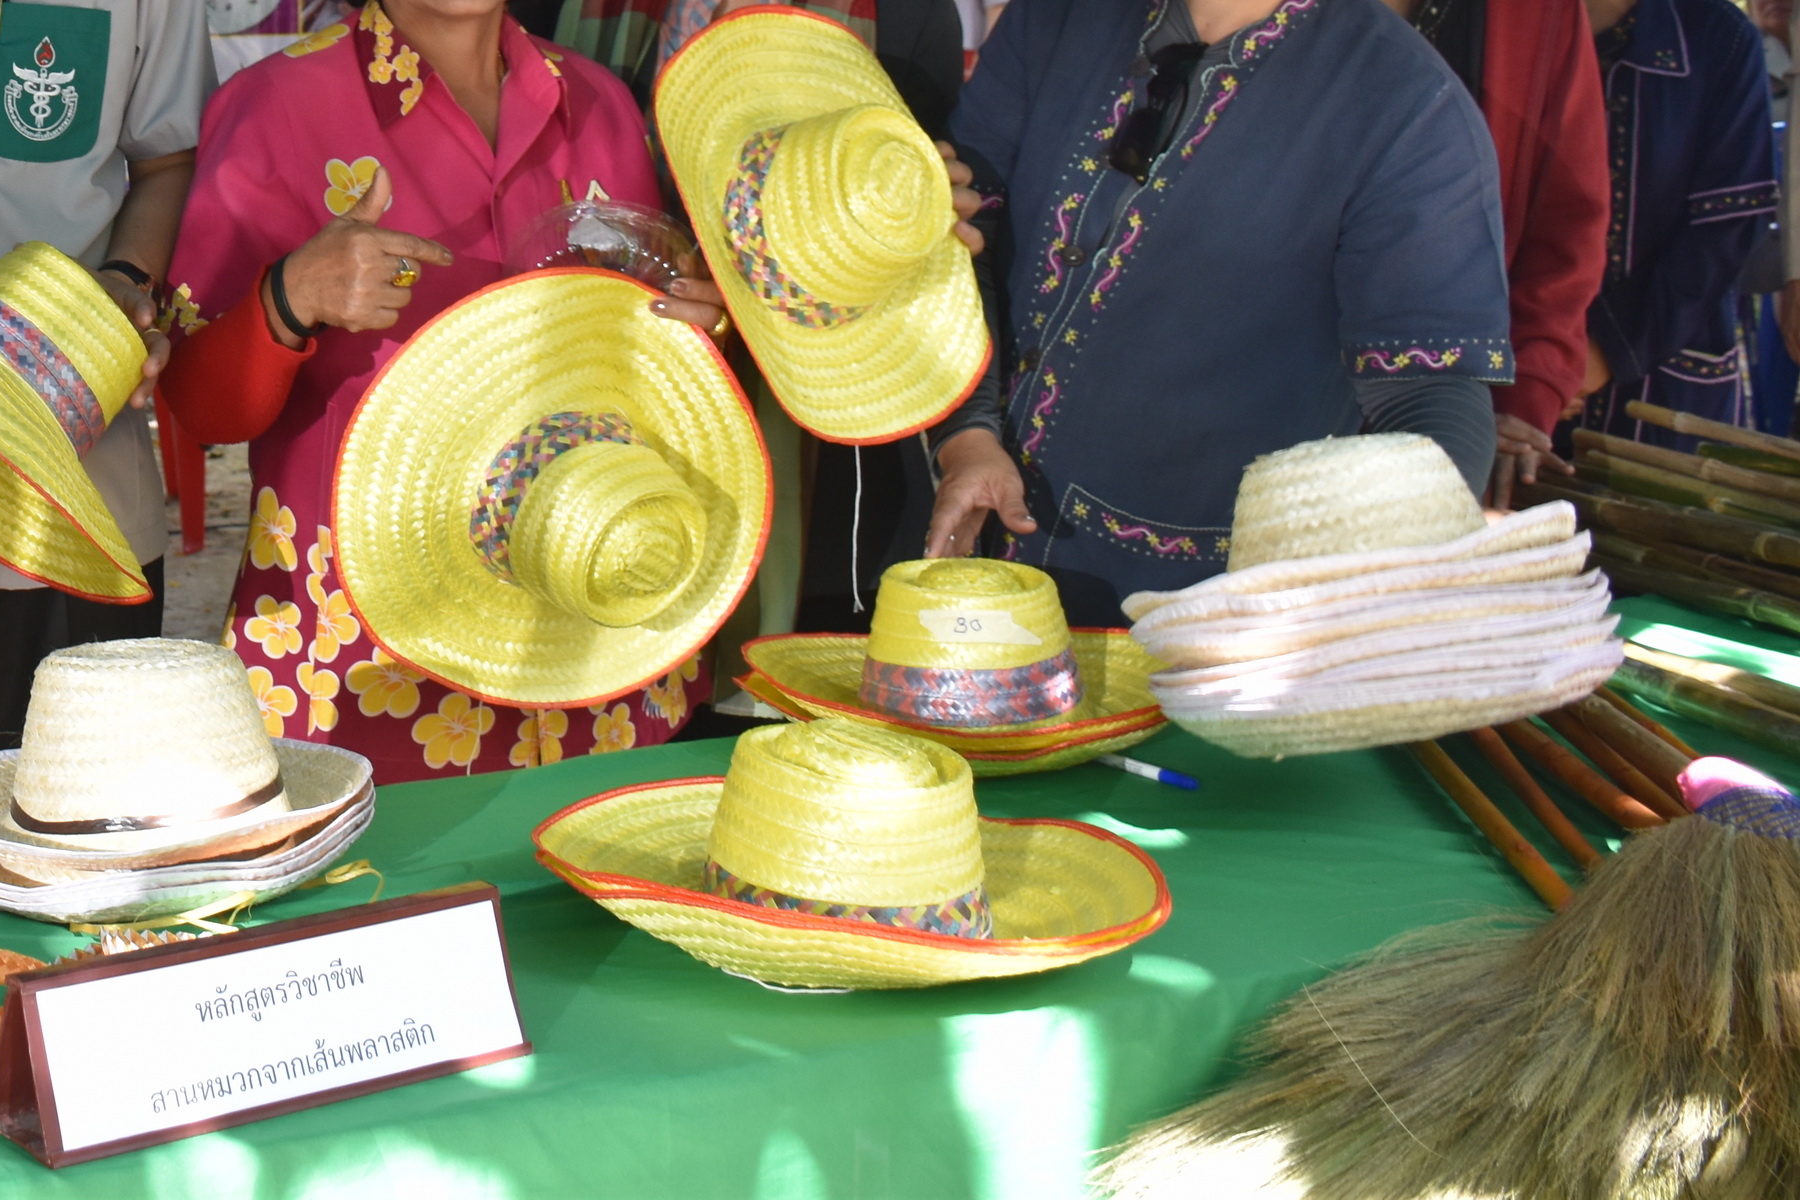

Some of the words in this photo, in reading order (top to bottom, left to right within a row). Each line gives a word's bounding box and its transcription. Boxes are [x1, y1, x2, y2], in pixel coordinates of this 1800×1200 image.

[195, 958, 366, 1023] หลักสูตรวิชาชีพ
[151, 1017, 436, 1114] สานหมวกจากเส้นพลาสติก
